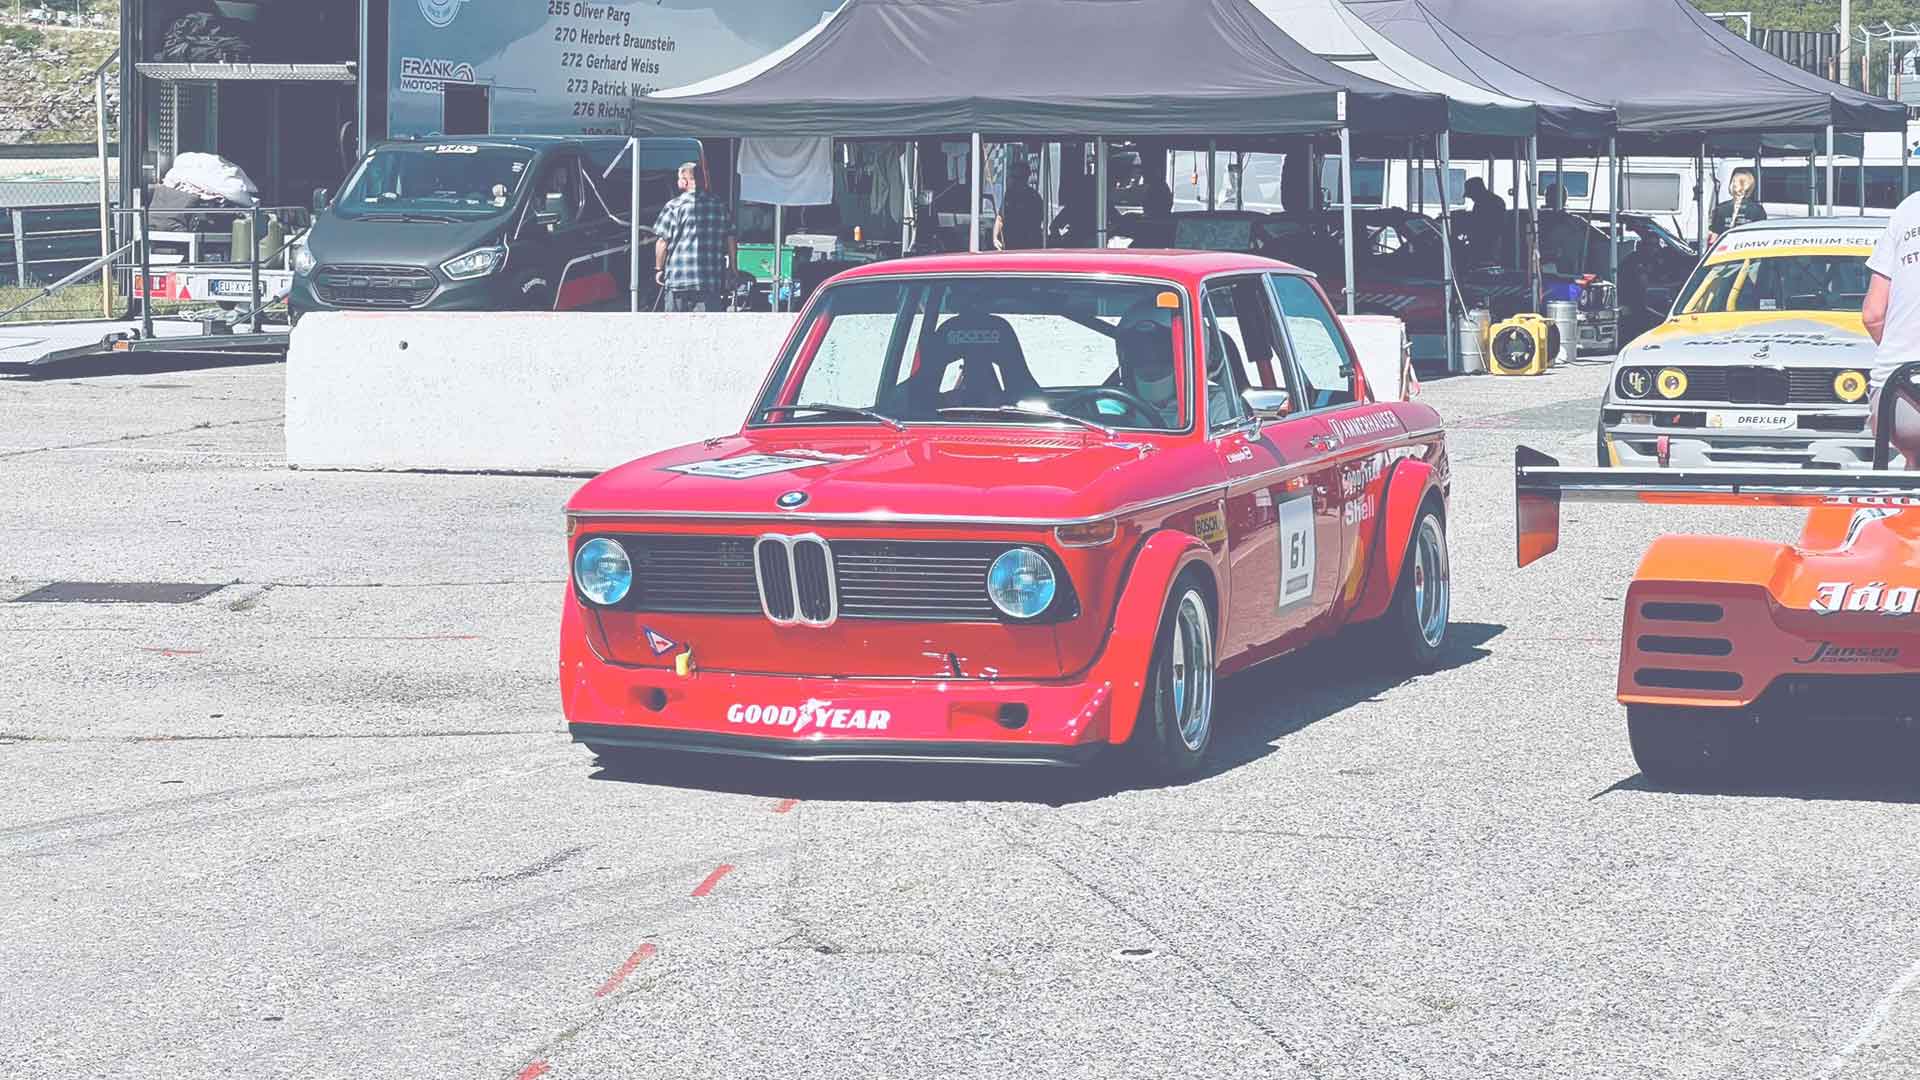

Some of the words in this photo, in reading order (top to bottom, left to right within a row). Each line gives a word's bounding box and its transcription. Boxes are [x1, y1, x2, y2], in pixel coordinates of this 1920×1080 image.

[548, 0, 570, 15] 255
[573, 3, 604, 19] Oliver
[607, 6, 631, 26] Parg
[554, 27, 577, 42] 270
[580, 28, 621, 46] Herbert
[623, 33, 676, 51] Braunstein
[403, 59, 452, 77] FRANK
[561, 52, 583, 67] 272
[586, 54, 628, 71] Gerhard
[631, 57, 660, 74] Weiss
[402, 80, 446, 92] MOTORS
[567, 78, 588, 93] 273
[591, 80, 627, 96] Patrick
[631, 83, 659, 97] Wei
[573, 102, 595, 117] 276
[598, 102, 632, 120] Richar
[1734, 240, 1770, 250] BMW
[1773, 238, 1842, 246] PREMIUM
[1738, 416, 1787, 424] DREXLER
[1345, 494, 1375, 525] Shell
[1196, 515, 1218, 535] BOSCH
[1290, 529, 1307, 569] 61
